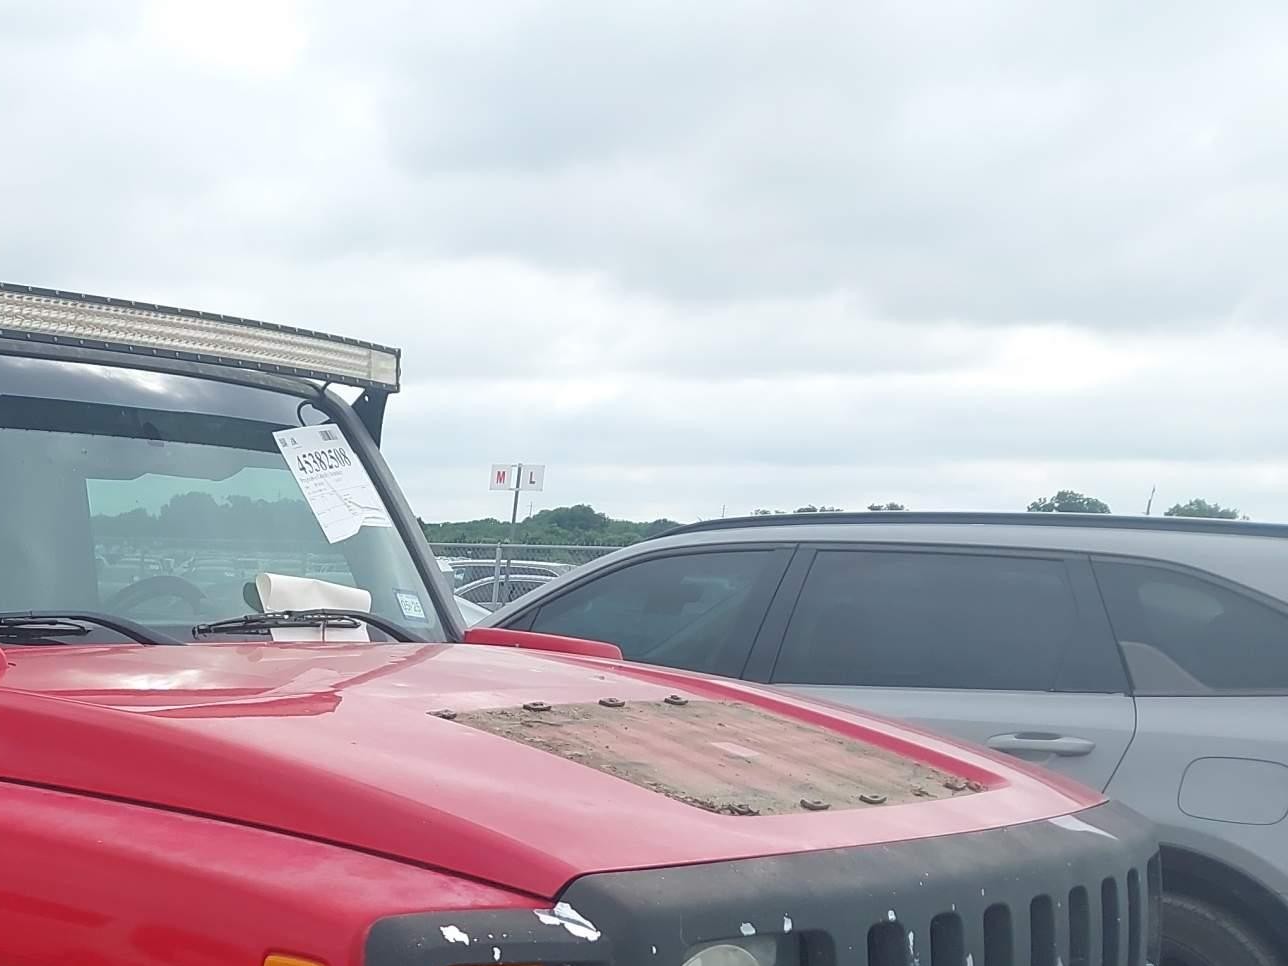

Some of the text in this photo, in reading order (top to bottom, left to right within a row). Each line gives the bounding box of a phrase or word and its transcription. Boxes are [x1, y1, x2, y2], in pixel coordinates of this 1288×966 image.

[296, 448, 352, 475] 45382508
[496, 471, 506, 484] M
[529, 471, 536, 484] L
